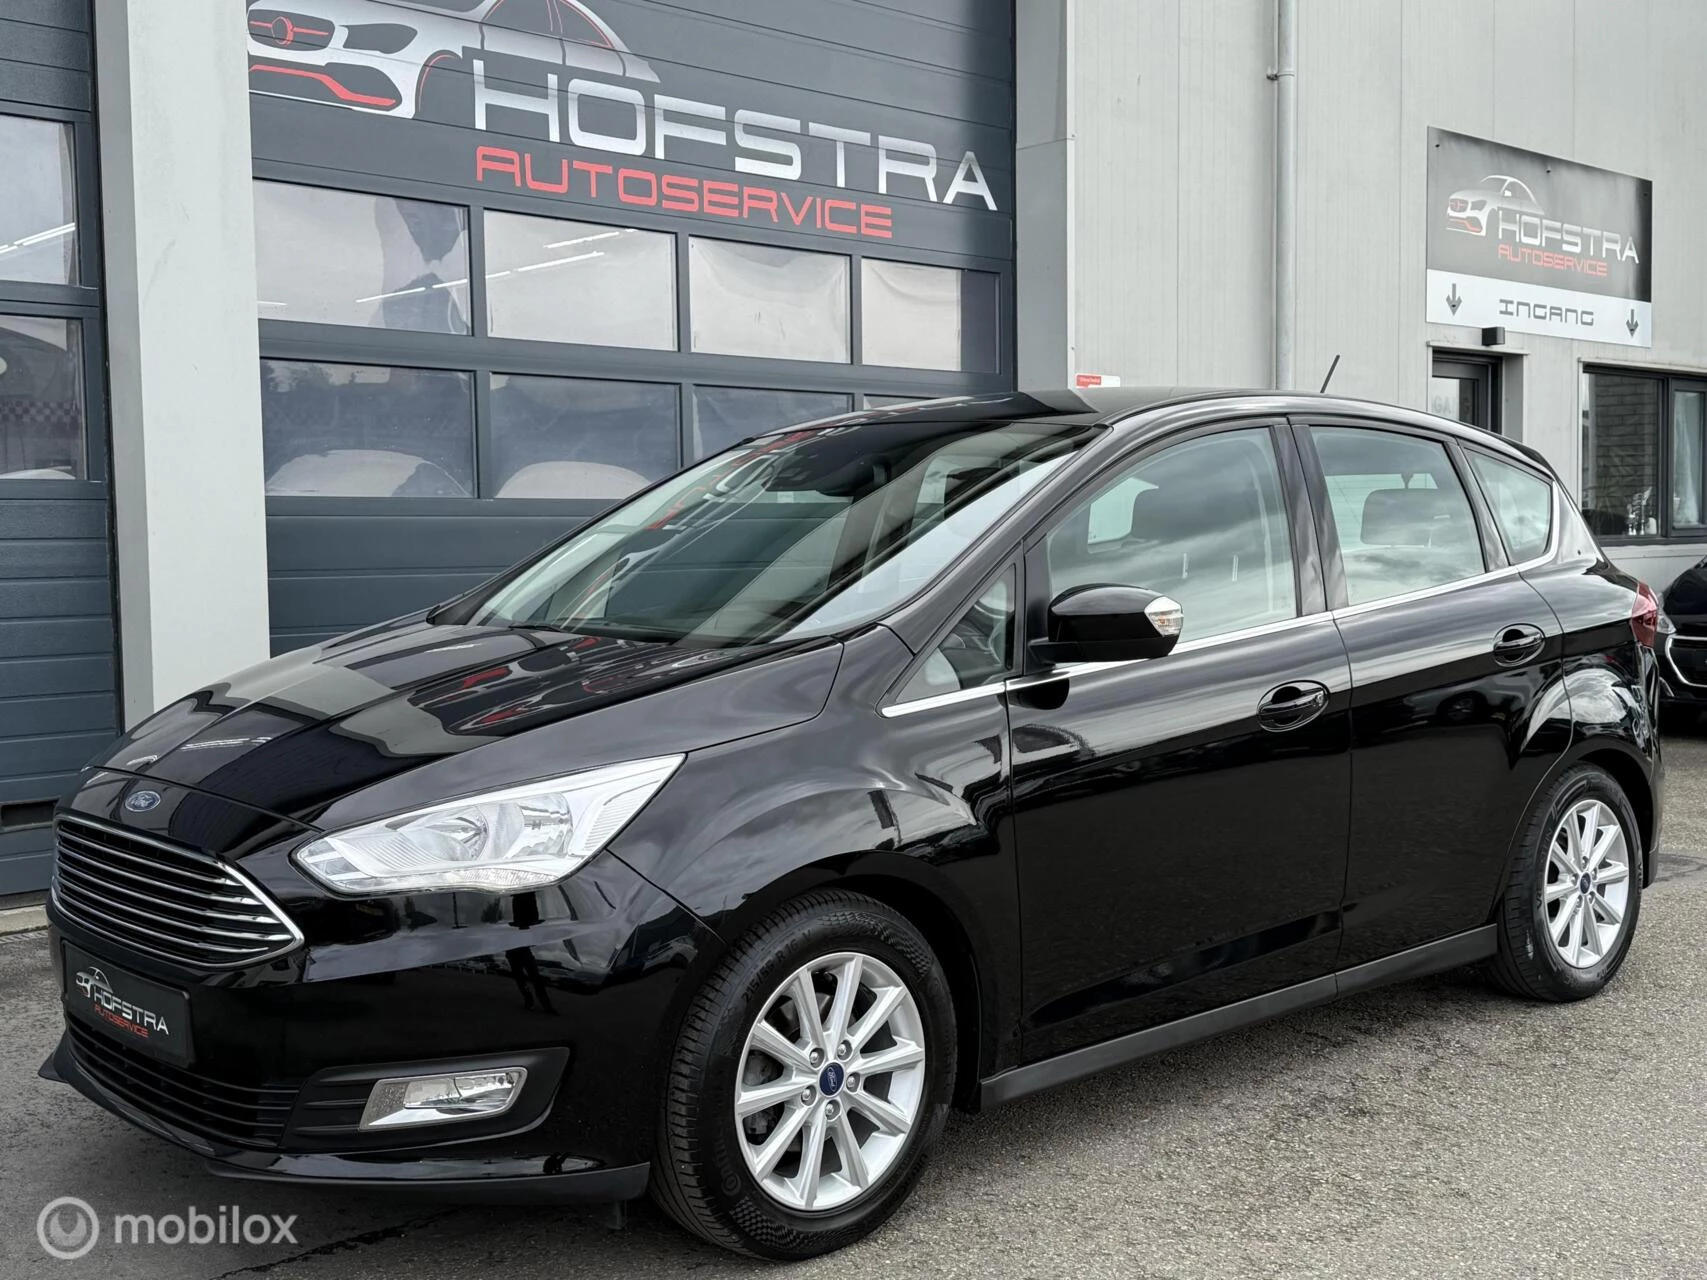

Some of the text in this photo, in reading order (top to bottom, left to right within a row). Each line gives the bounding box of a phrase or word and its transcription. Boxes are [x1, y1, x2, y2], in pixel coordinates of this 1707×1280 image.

[472, 58, 997, 212] HOFSTRA
[475, 145, 893, 239] AUTOSERVICE
[1498, 210, 1639, 263] HOFSTRA
[1498, 245, 1608, 276] AUTOSERVICE
[1499, 298, 1595, 327] INGANG
[93, 986, 169, 1035] HOFSTRA
[95, 1005, 149, 1038] AUTOSERVICE
